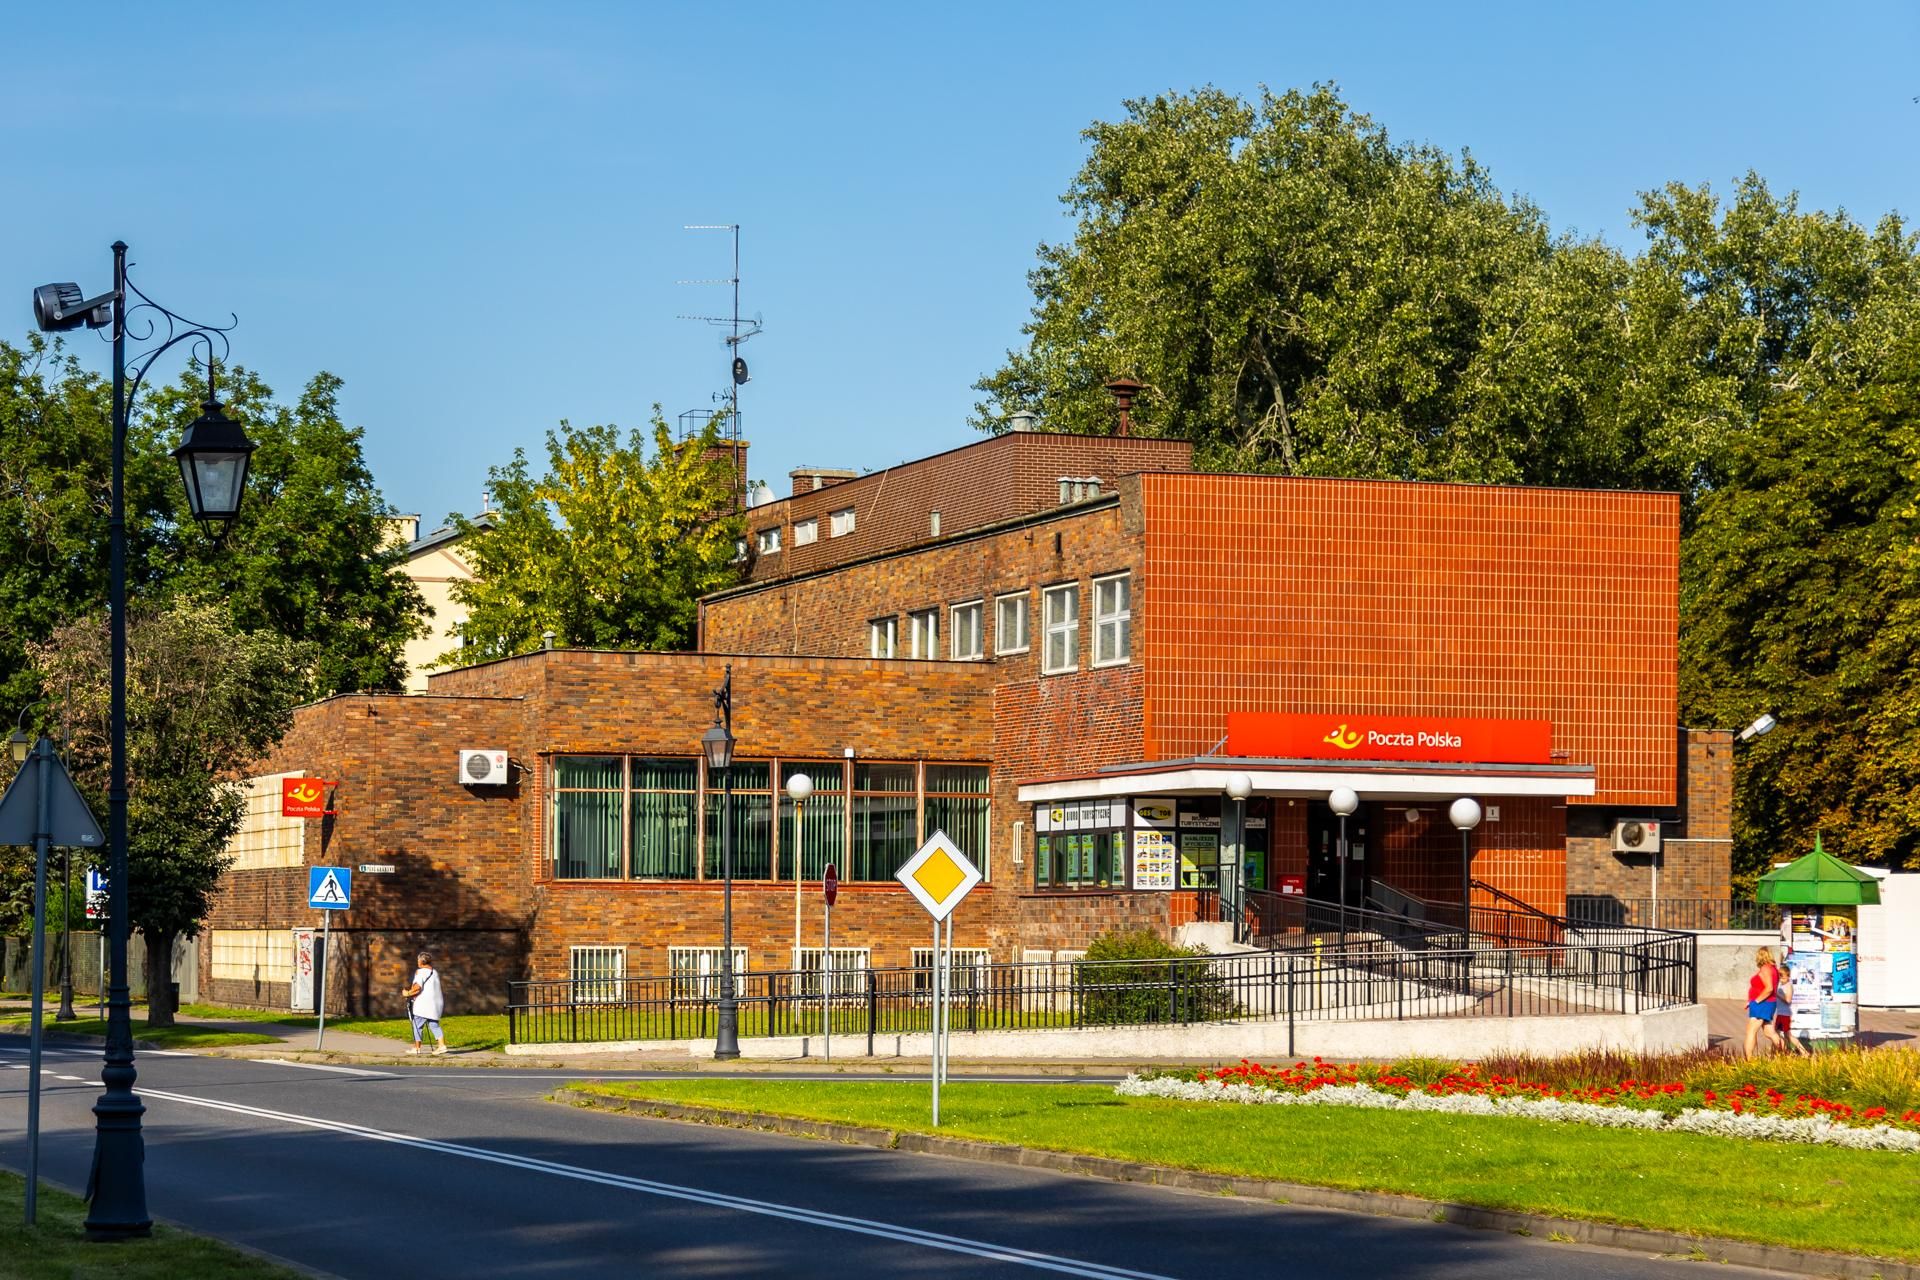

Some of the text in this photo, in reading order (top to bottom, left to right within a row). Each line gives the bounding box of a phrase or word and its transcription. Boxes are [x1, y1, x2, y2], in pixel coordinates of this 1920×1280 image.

[1368, 731, 1461, 747] Poczta Polska
[1066, 811, 1079, 822] BIURO
[1081, 808, 1110, 820] TURYSTYCZNE
[826, 879, 836, 891] STOP
